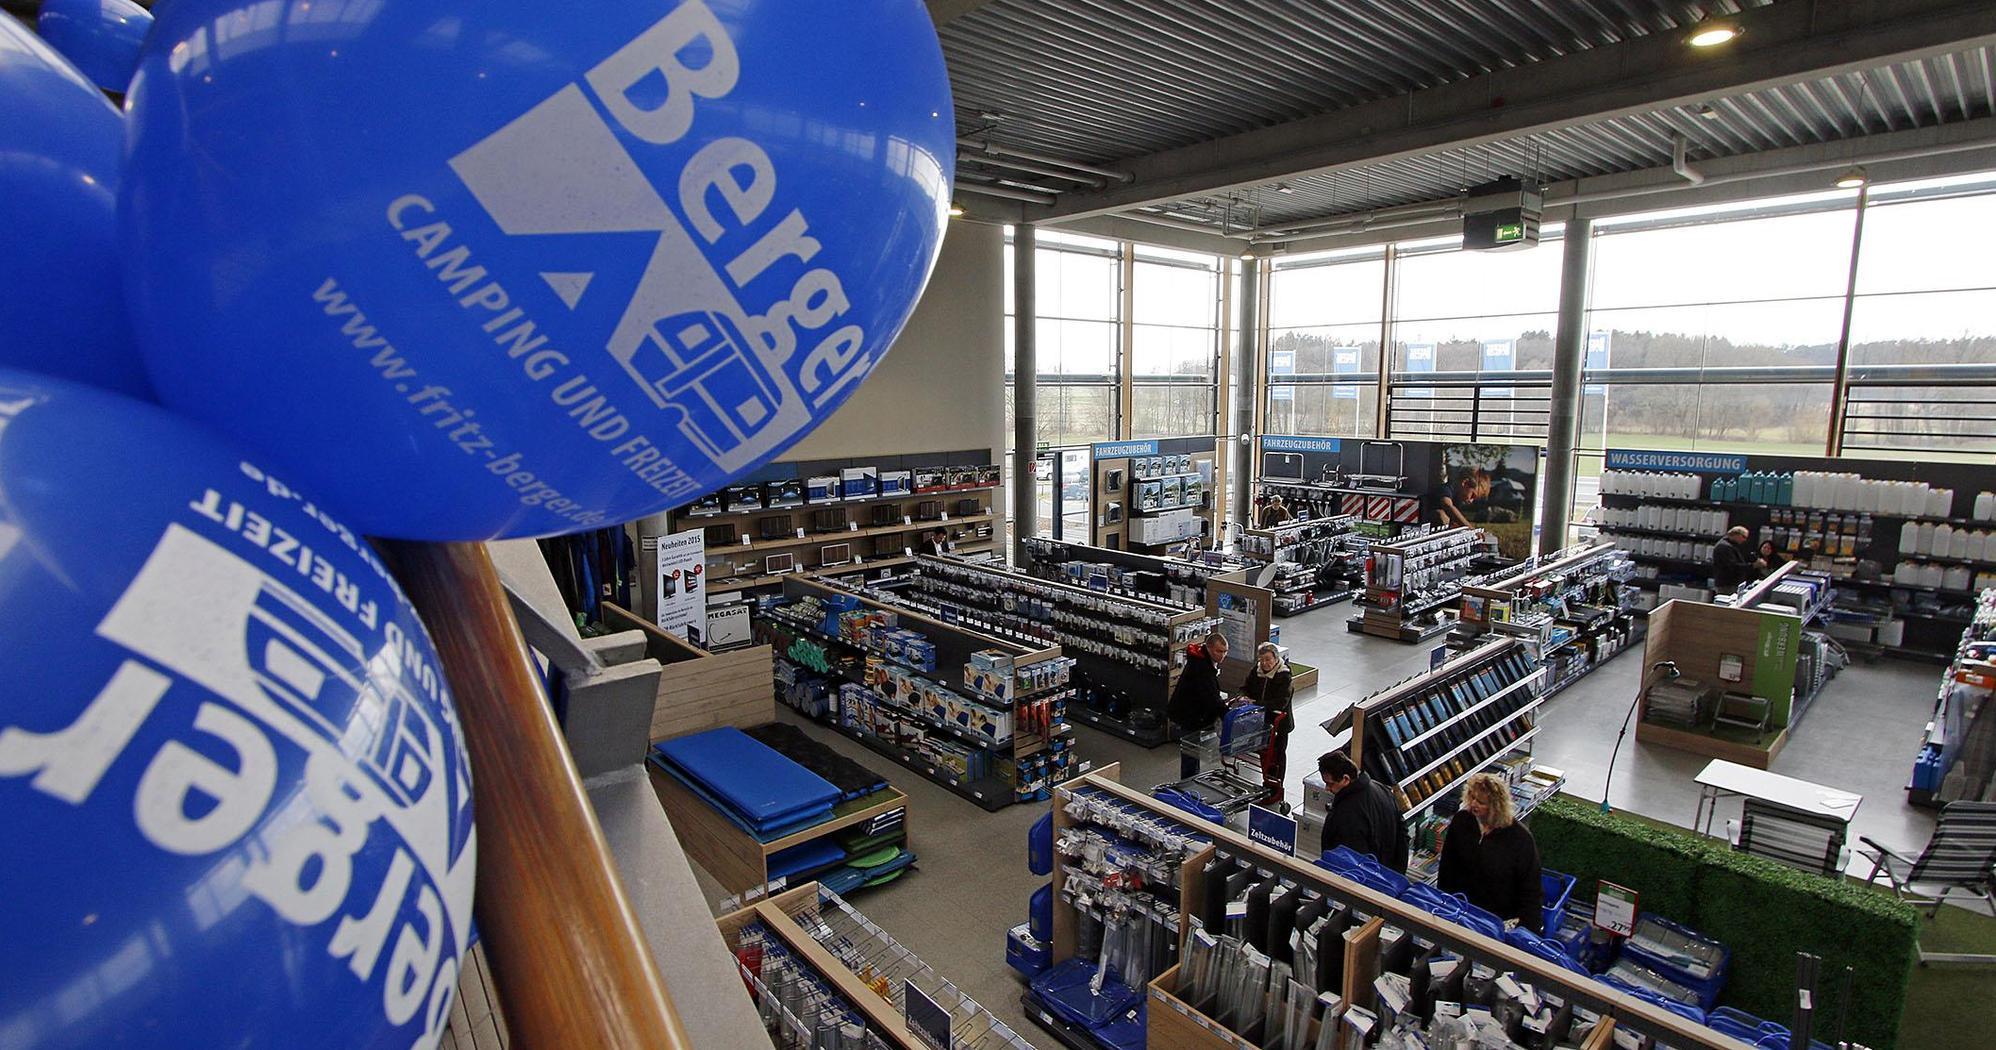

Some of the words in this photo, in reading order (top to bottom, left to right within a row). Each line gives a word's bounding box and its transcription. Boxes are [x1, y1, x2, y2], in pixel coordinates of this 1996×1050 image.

[584, 0, 874, 409] Berger
[386, 192, 569, 383] CAMPING
[556, 367, 628, 443] UND
[610, 424, 704, 499] FREIZEIT
[312, 277, 607, 527] www.fritz-berger.de
[1095, 443, 1153, 457] FAHRZEUGZUBEHÖR
[1263, 437, 1332, 451] FAHRZEUGZUBEHÖR
[1610, 452, 1741, 470] WASSERVERSORGUNG
[661, 539, 688, 552] Neuheiten
[687, 534, 701, 545] 2015
[188, 488, 379, 631] FREIZEIT
[707, 607, 748, 620] MEGASAT
[1250, 827, 1292, 852] Zeltzubehör
